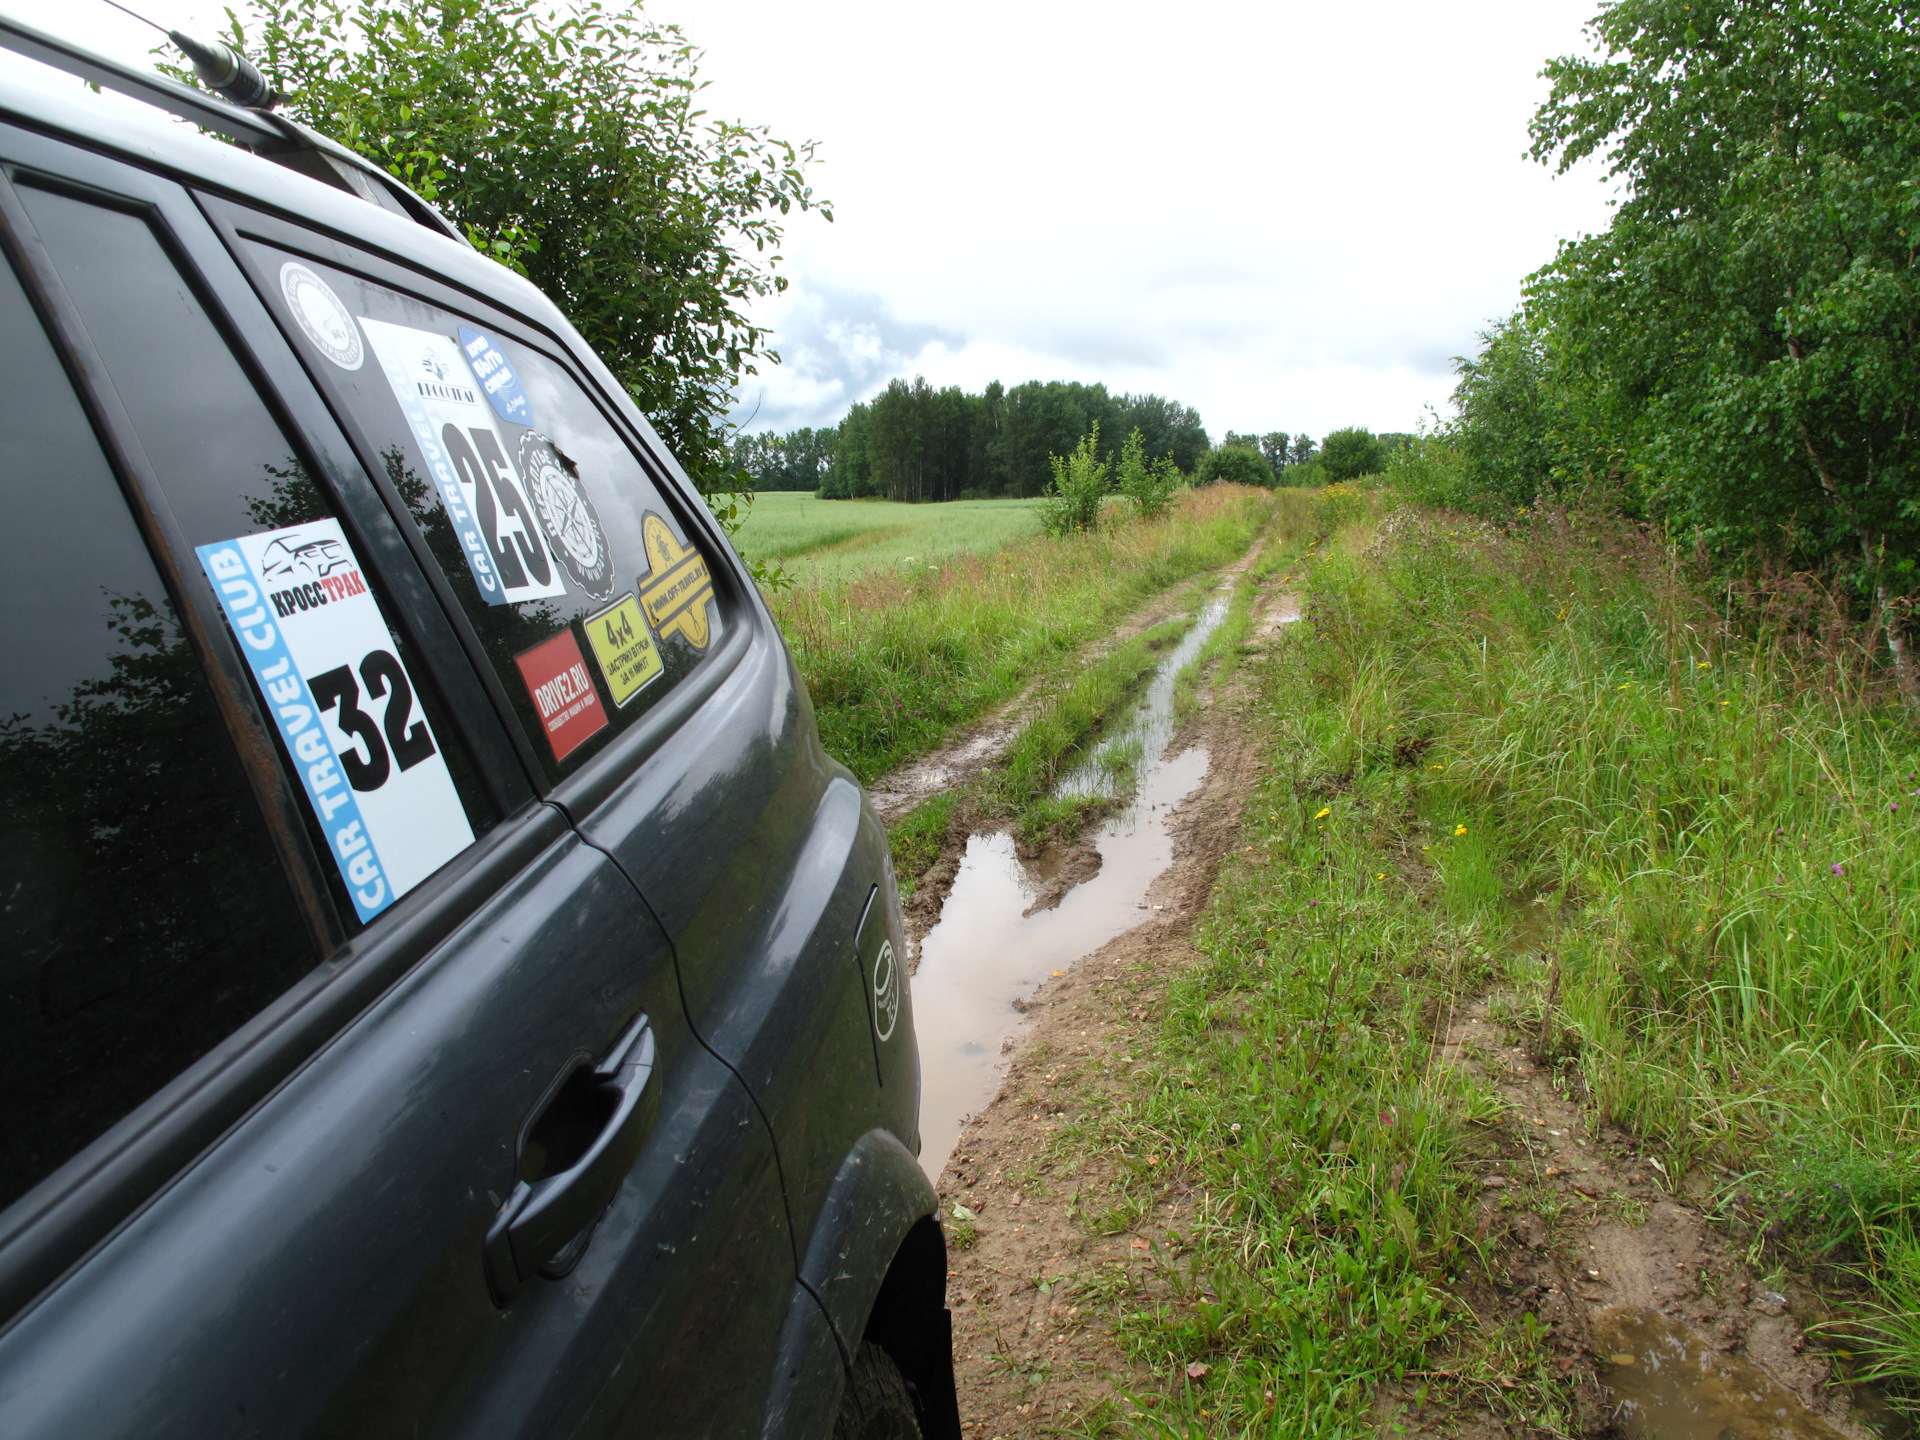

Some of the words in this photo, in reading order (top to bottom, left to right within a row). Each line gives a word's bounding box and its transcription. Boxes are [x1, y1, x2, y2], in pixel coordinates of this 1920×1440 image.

[411, 412, 470, 523] TRAVEL
[441, 422, 552, 590] 25
[530, 449, 558, 537] ПЕРЕПУТЬЕ
[209, 547, 276, 651] CLUB
[270, 570, 367, 618] КРОССТРАК
[464, 529, 496, 592] CAR
[306, 649, 437, 792] 32
[534, 662, 590, 718] DRIVE2.RU
[620, 670, 630, 685] ЗА
[261, 656, 352, 821] TRAVEL
[336, 820, 386, 910] CAR
